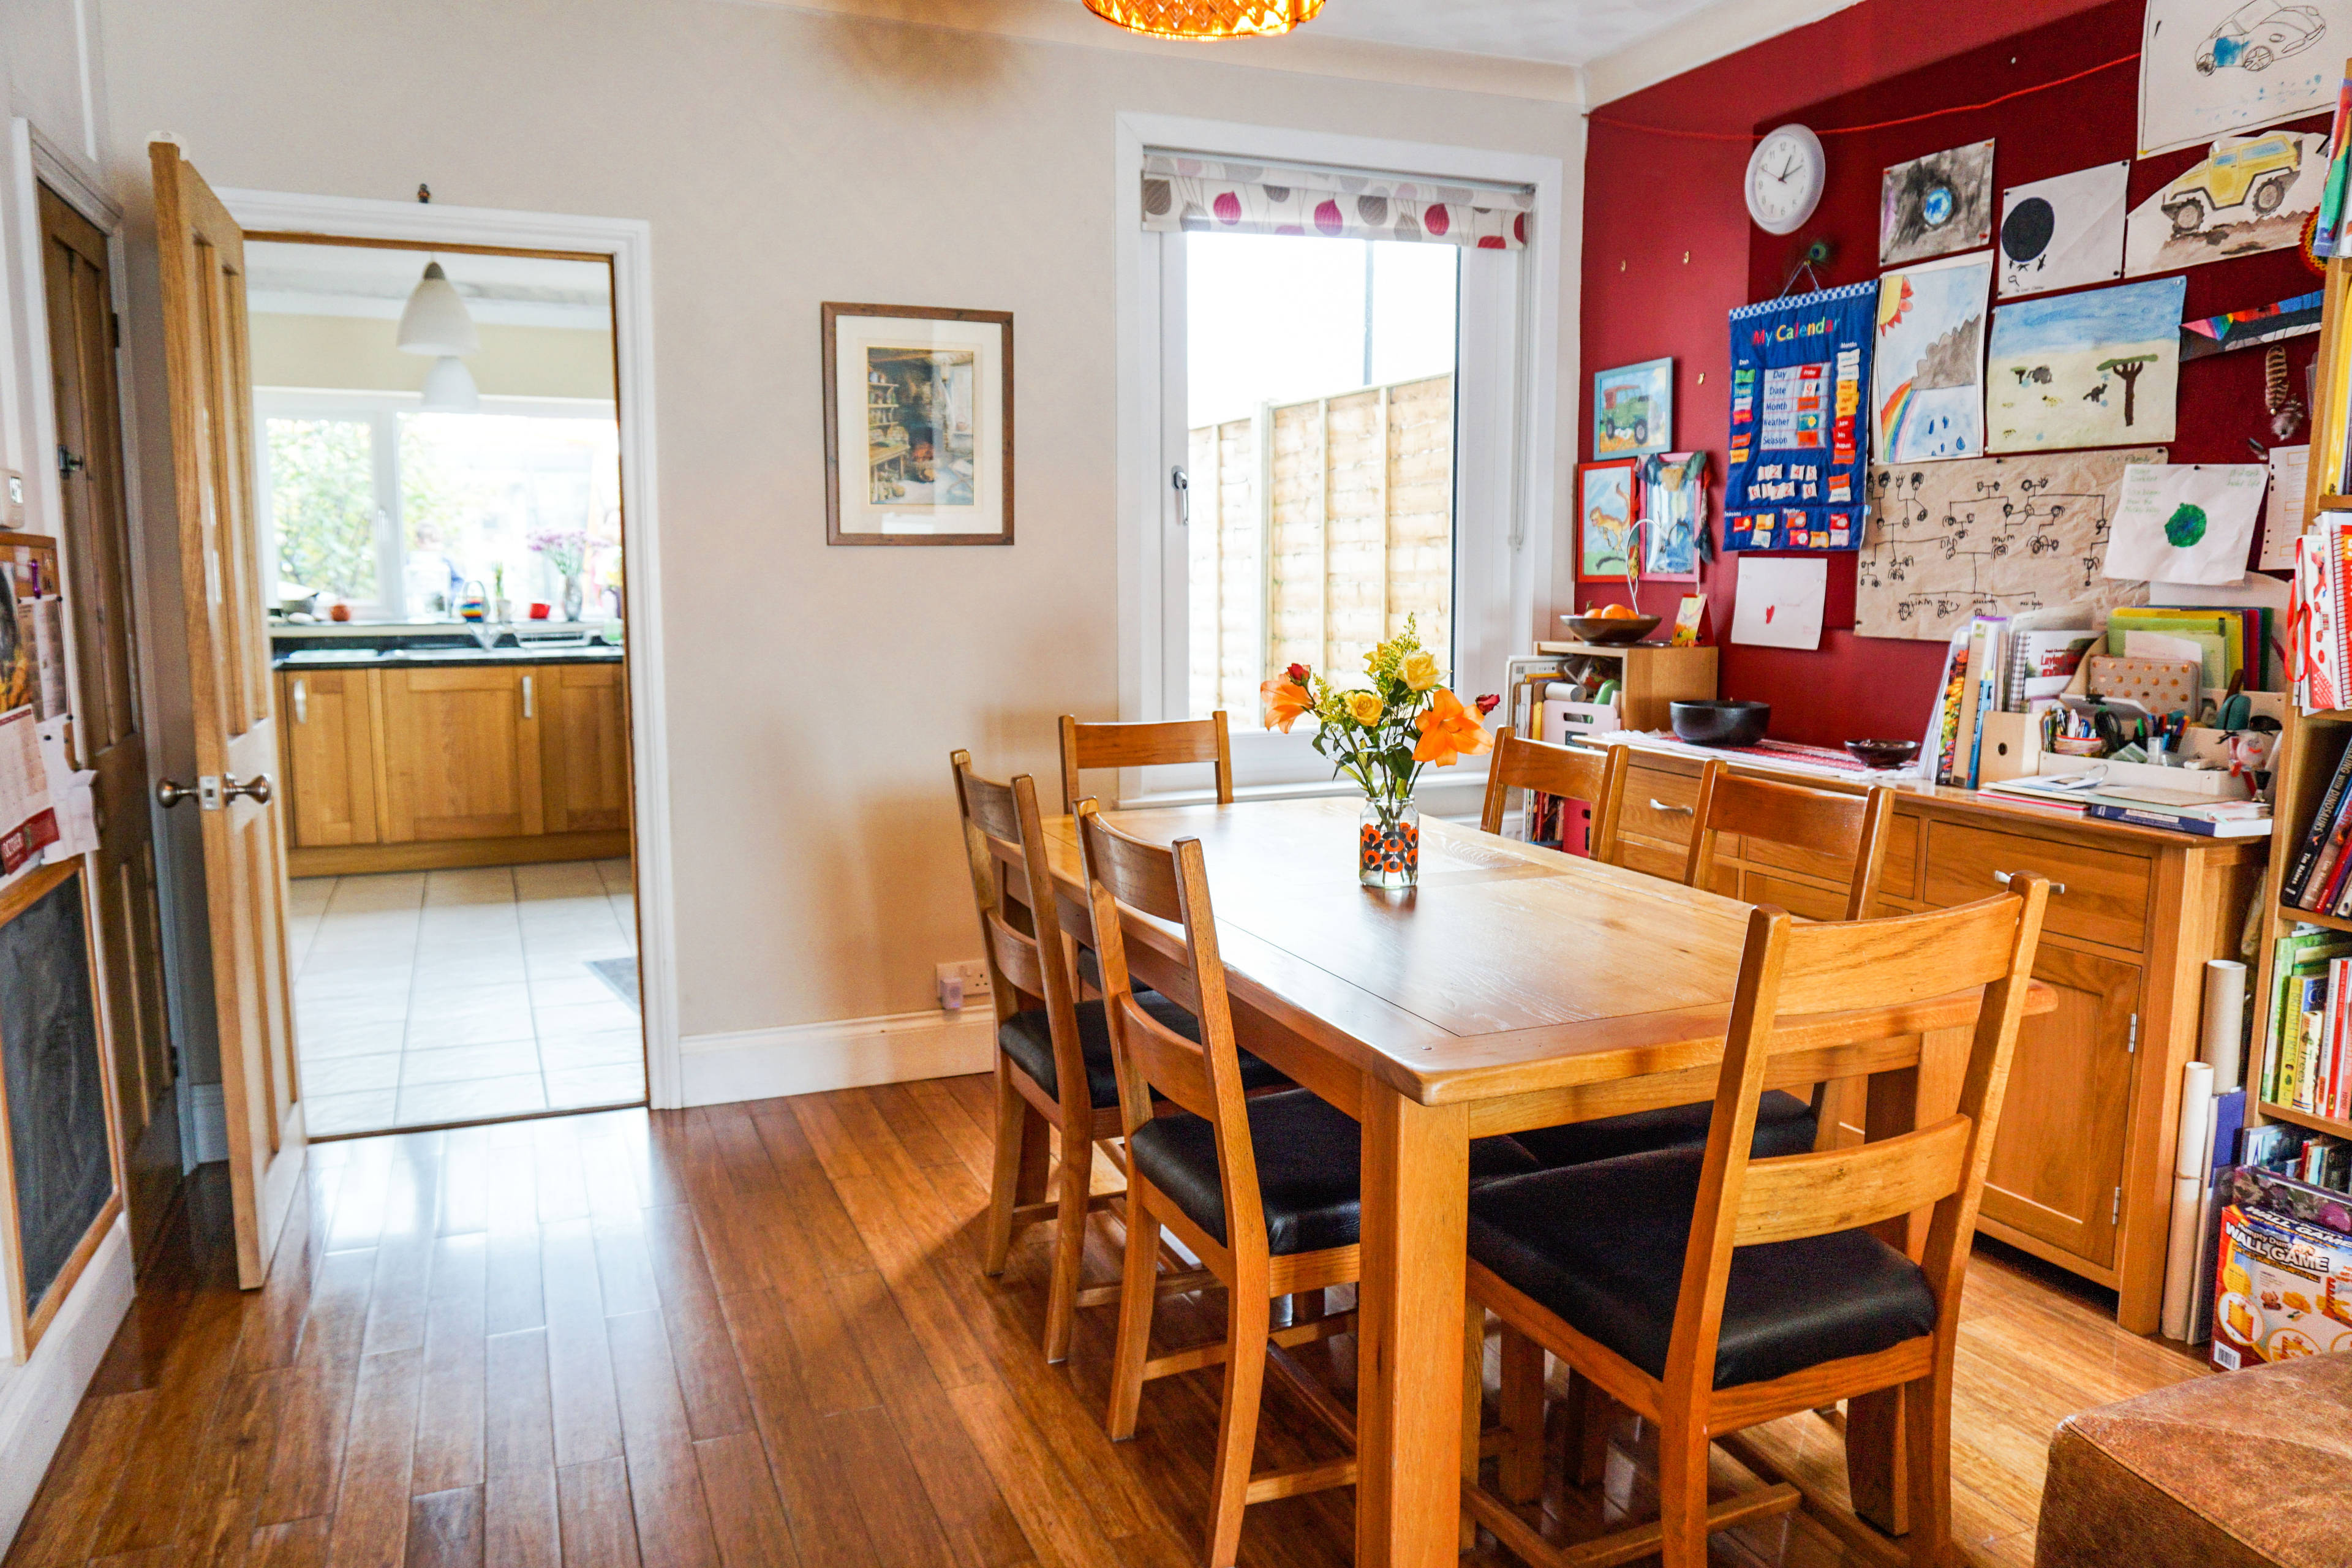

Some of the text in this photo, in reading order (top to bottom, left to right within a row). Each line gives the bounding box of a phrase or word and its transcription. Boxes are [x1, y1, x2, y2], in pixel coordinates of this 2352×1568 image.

[1780, 141, 1787, 152] 12
[1769, 150, 1776, 160] 11
[1753, 316, 1840, 347] My Calendar
[1773, 370, 1787, 380] Day
[1770, 386, 1787, 395] Date
[1766, 401, 1787, 412] Month
[1763, 418, 1789, 426] Weather
[1763, 436, 1788, 446] Season
[1772, 465, 1778, 477] 2
[1795, 467, 1800, 476] 4
[1809, 468, 1814, 478] 5
[1752, 488, 1757, 497] 6
[1774, 487, 1779, 497] 7
[1785, 484, 1790, 494] 2
[2313, 788, 2340, 833] DINOSAURS
[2283, 992, 2301, 1063] BRITISH TREES
[2298, 1050, 2313, 1083] Trees
[2245, 1205, 2291, 1229] WALL
[2295, 1226, 2352, 1248] GAME
[2238, 1222, 2268, 1243] Humpty
[2225, 1221, 2267, 1256] WALL
[2271, 1245, 2329, 1272] GAME
